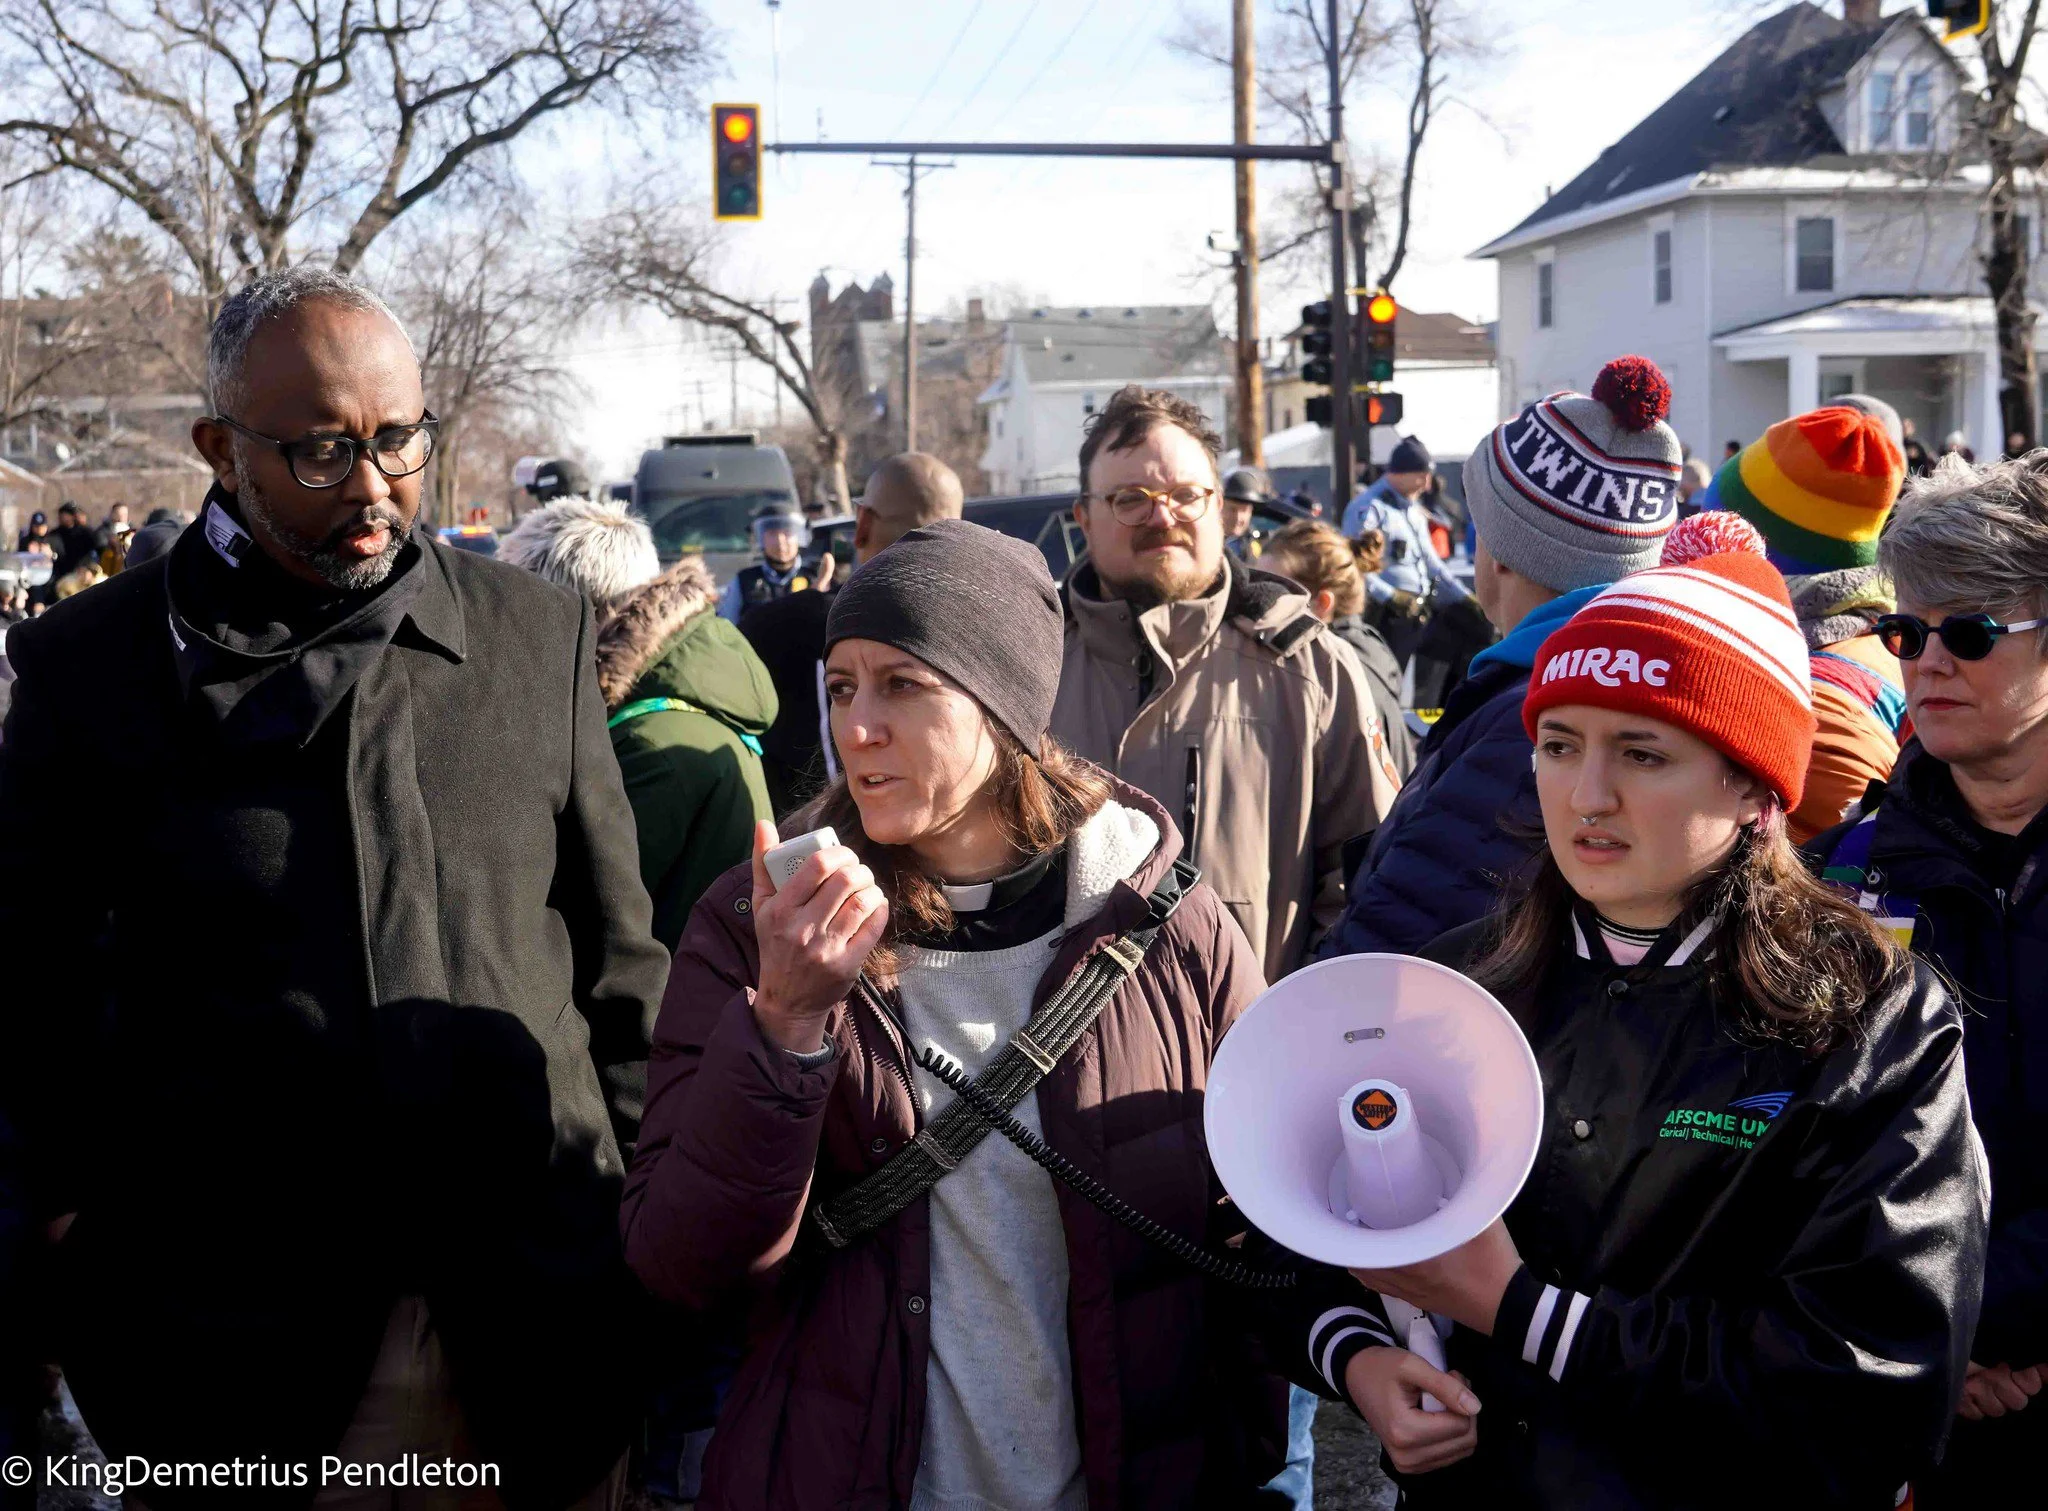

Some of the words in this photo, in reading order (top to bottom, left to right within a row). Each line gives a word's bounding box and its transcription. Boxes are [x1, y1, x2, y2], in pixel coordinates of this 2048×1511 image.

[1511, 412, 1666, 520] TWINS
[1541, 647, 1671, 687] MIRAC
[1664, 1110, 1736, 1131] AFSCME
